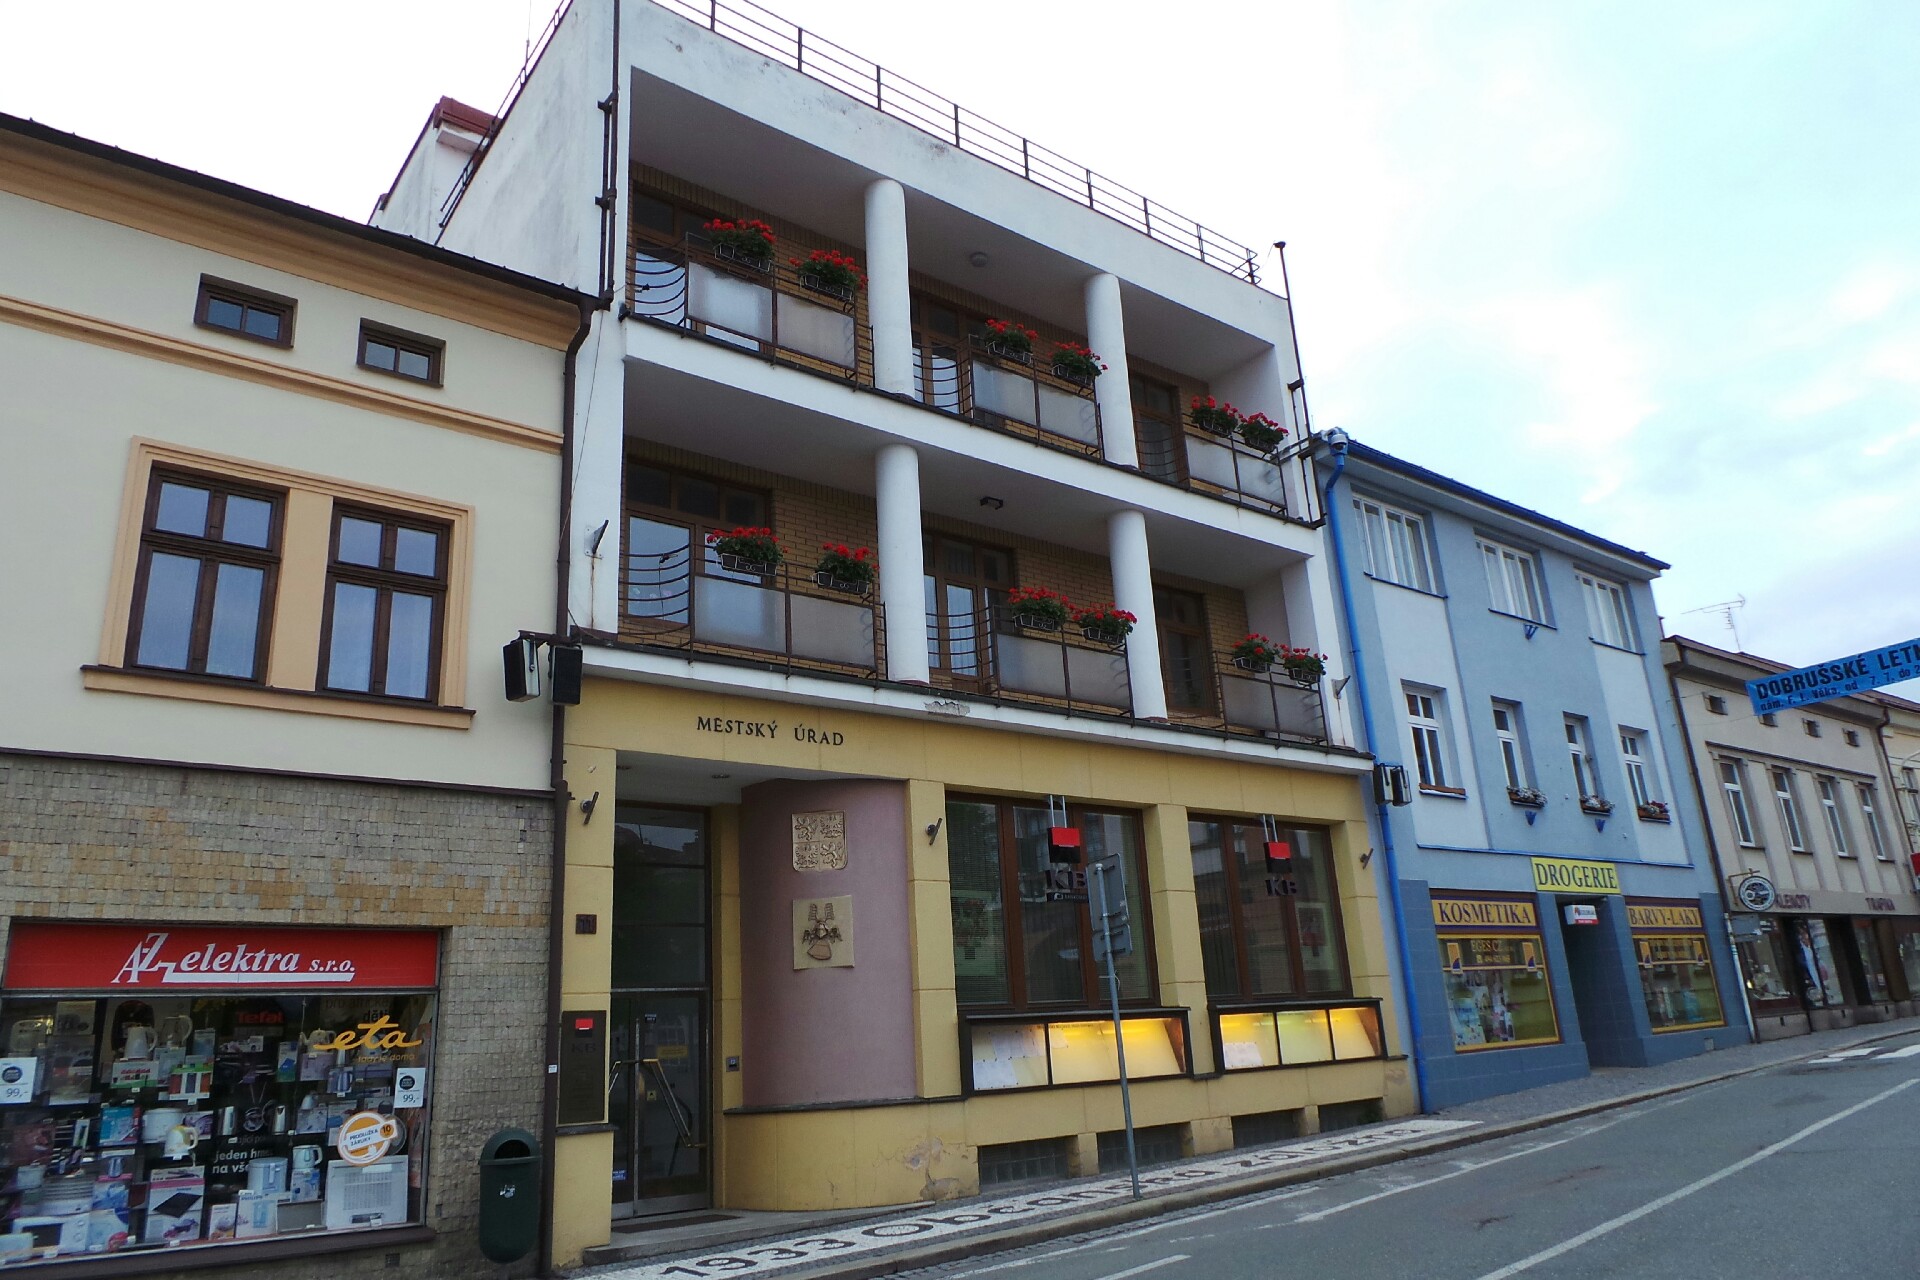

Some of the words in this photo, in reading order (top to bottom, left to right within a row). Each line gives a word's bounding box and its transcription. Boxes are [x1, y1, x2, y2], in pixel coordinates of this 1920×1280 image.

[1756, 654, 1869, 700] DOBRUŠSKÉ
[1760, 699, 1784, 711] nám.
[1845, 680, 1858, 691] od
[1883, 671, 1895, 682] 7.
[1899, 668, 1911, 678] do
[1045, 869, 1088, 890] KB
[1265, 878, 1297, 897] KB
[1535, 863, 1617, 889] DROGERIE
[1438, 902, 1532, 923] KOSMETIKA
[1629, 908, 1700, 926] BARVY-LAKY
[180, 943, 300, 972] elektra
[309, 959, 355, 972] s.r.o.
[313, 1014, 422, 1050] eta
[213, 1149, 248, 1164] jeden
[212, 1164, 229, 1174] na
[660, 1239, 857, 1277] 1933
